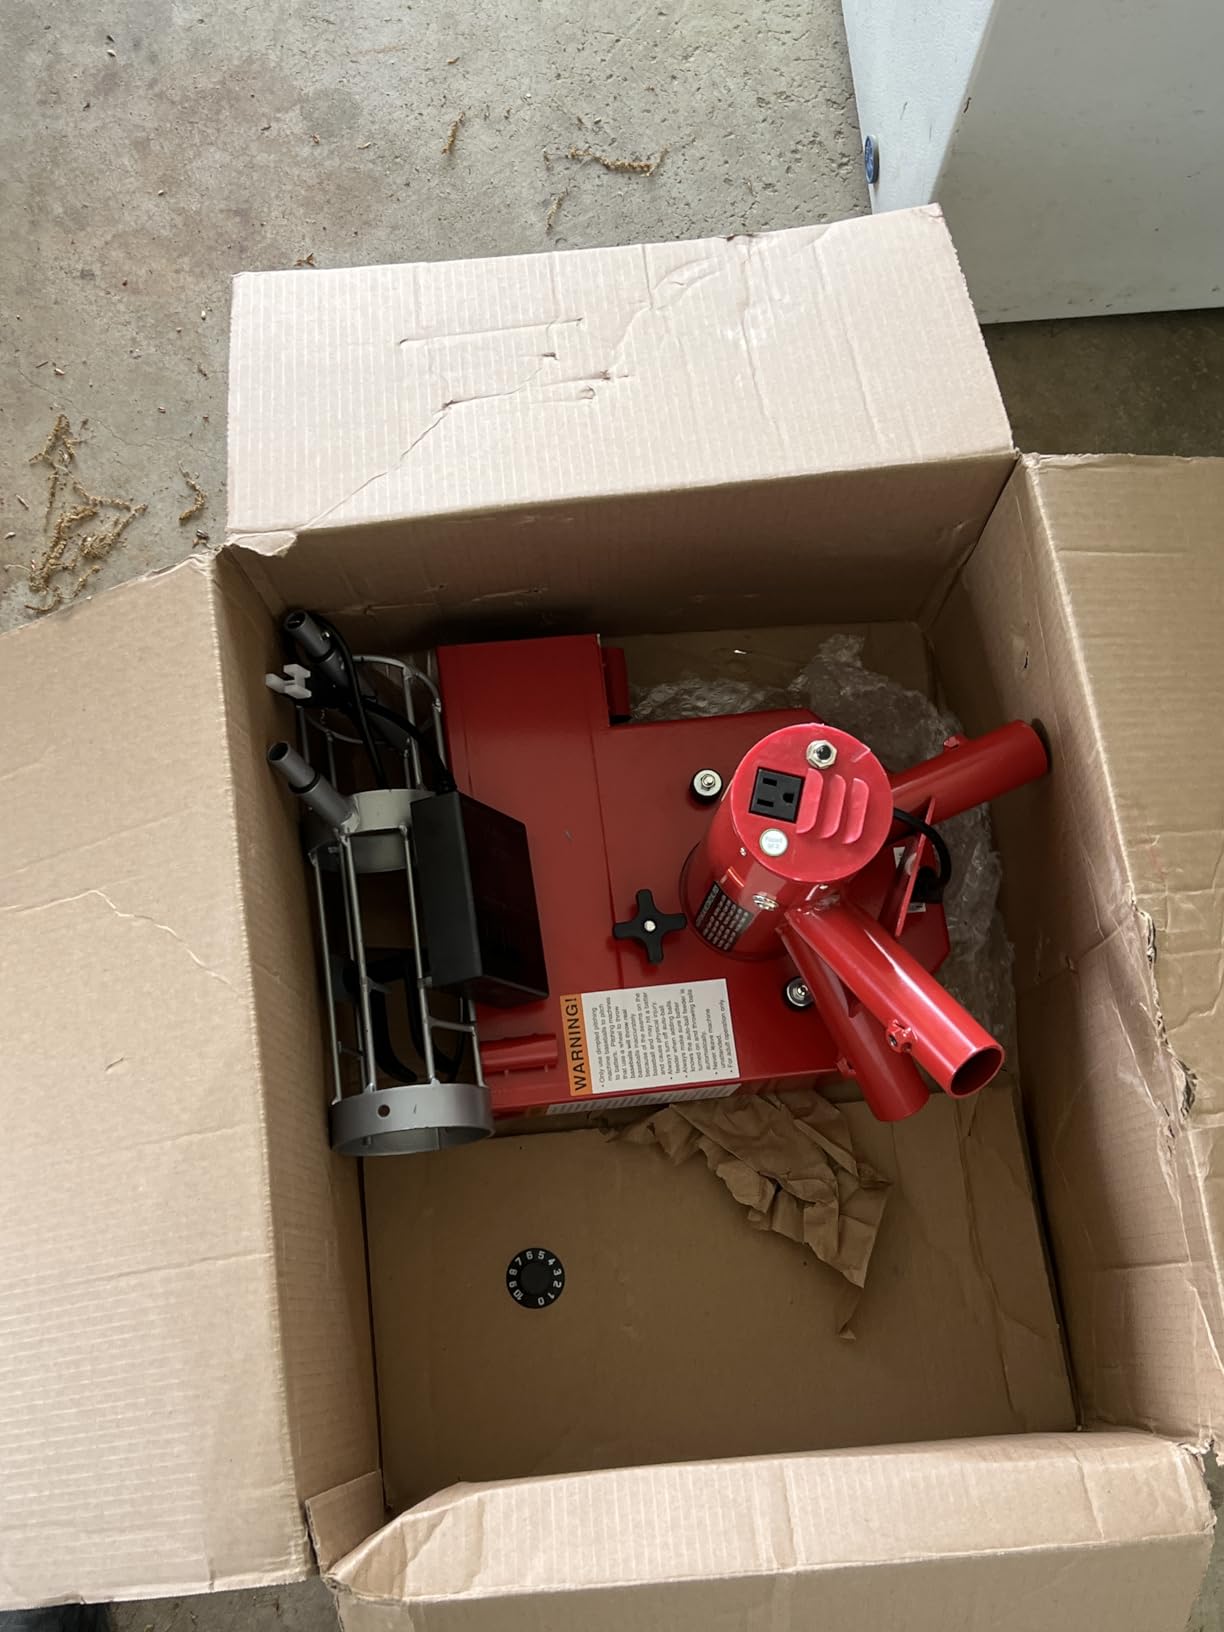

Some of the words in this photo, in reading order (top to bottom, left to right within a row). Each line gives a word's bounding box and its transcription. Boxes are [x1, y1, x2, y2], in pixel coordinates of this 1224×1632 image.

[565, 998, 587, 1091] WARNING!
[526, 1251, 533, 1260] 6
[538, 1250, 545, 1260] 5
[515, 1256, 522, 1266] 7
[548, 1258, 556, 1266] 4
[509, 1268, 518, 1276] 8
[553, 1268, 562, 1276] 3
[553, 1280, 562, 1288] 2
[513, 1289, 523, 1300] 10
[538, 1297, 544, 1306] 0
